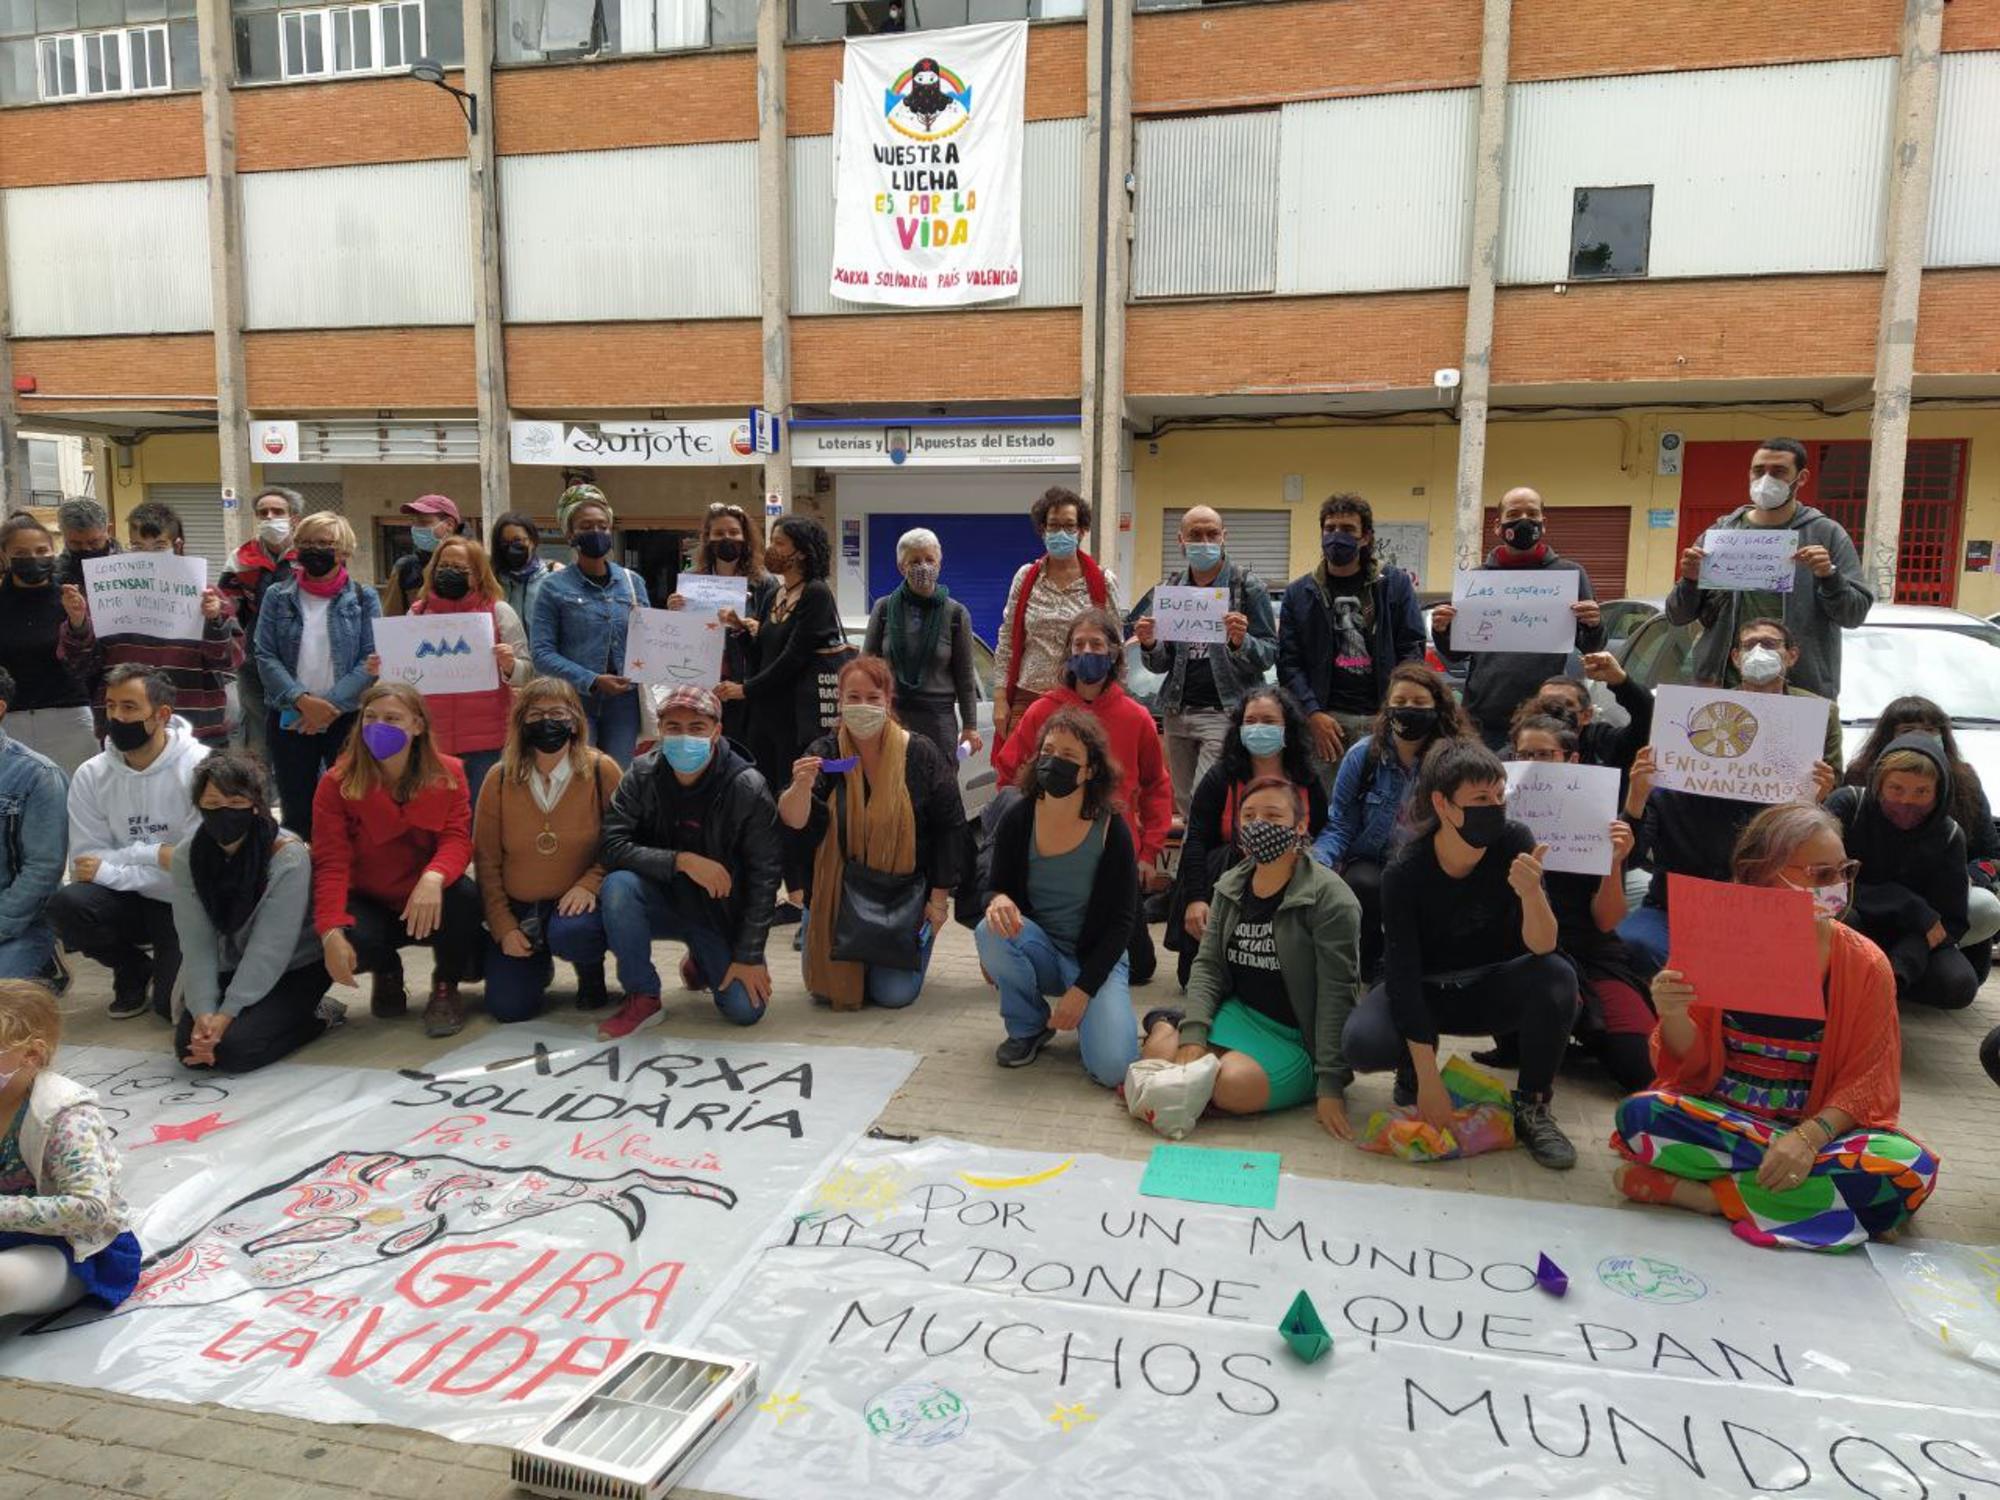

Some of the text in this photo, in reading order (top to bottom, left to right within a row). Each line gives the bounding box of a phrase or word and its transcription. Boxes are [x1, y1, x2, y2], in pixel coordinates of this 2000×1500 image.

[873, 143, 960, 166] VUESTRA
[892, 170, 958, 191] LUCHA
[874, 191, 976, 214] ES POR LA
[896, 216, 969, 250] VIDA
[834, 267, 869, 285] XARXA
[573, 426, 714, 460] Quijote
[818, 433, 1055, 451] Loterías y Apuestas del Estado
[93, 578, 155, 592] DEFENSANT
[173, 583, 198, 596] VIDA
[1465, 580, 1495, 597] Las
[1159, 599, 1208, 611] BUEN
[1174, 619, 1224, 632] VIAJE
[1684, 776, 1804, 797] AVANZAMOS
[914, 1183, 1537, 1293] POR UN MUNDO
[393, 1241, 686, 1331] GIRA
[963, 1246, 1260, 1321] DONDE
[263, 1288, 362, 1322] PER
[200, 1305, 631, 1401] LA VIDA
[828, 1301, 1280, 1416] MUCHOS
[1404, 1376, 2000, 1500] MUNDOS
